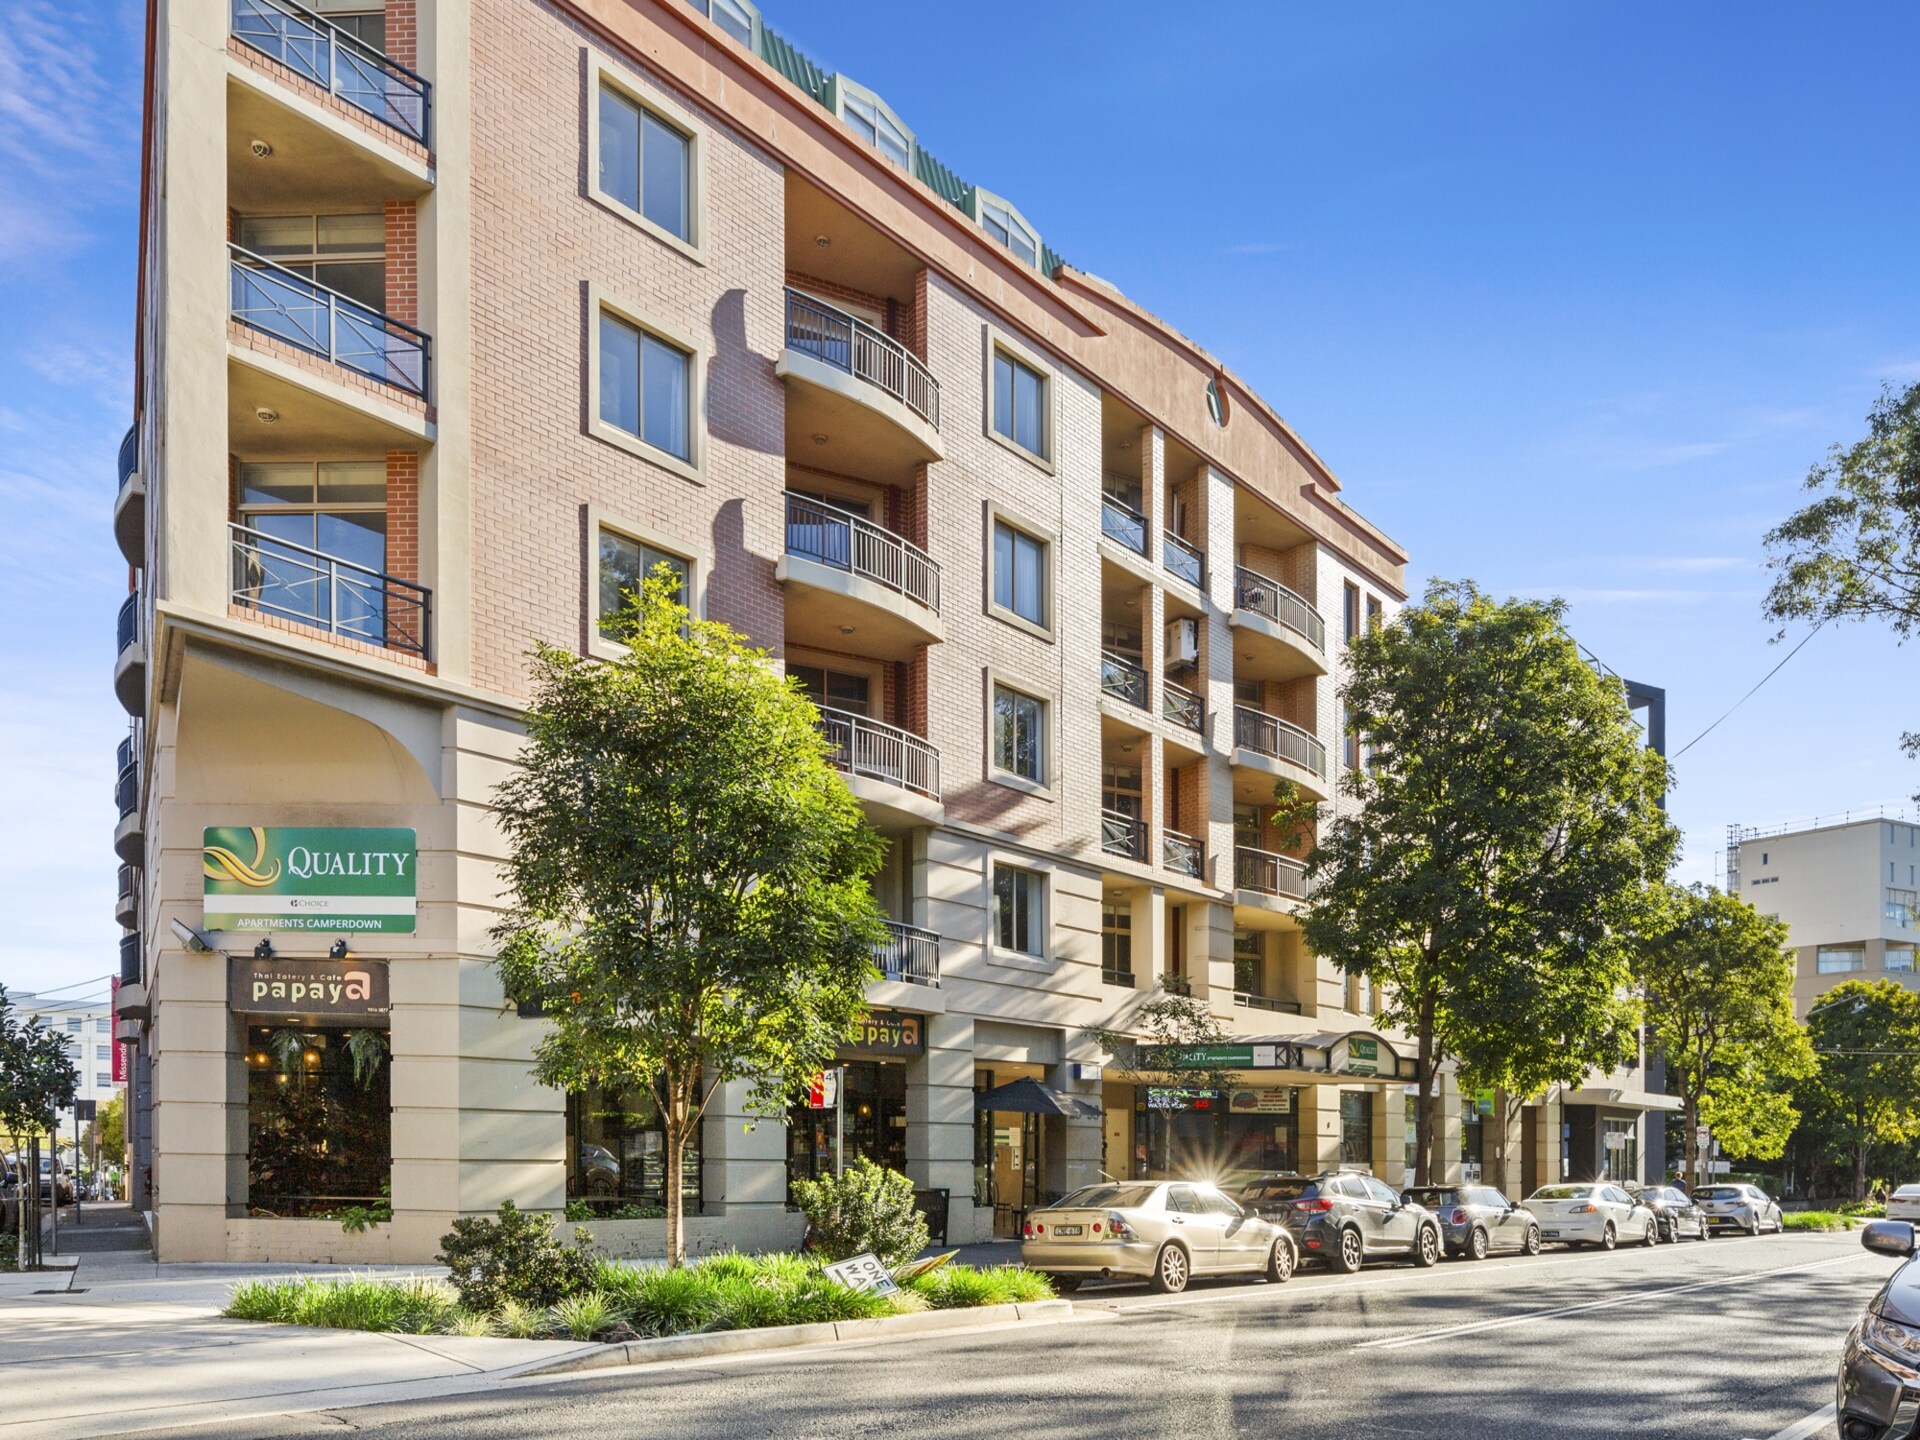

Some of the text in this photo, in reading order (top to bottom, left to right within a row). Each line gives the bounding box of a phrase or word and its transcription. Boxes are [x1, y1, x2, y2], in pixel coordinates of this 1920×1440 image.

[288, 846, 410, 879] QUALITY
[298, 900, 329, 908] CHOICE
[237, 918, 382, 929] APARTMENTS CAMPERDOWN
[252, 971, 371, 1005] papaya
[253, 972, 273, 980] Thai
[276, 973, 306, 982] Eatery
[319, 974, 342, 982] Cafe
[854, 1018, 919, 1049] apaya
[119, 1043, 128, 1080] Missende
[845, 1263, 867, 1286] WA
[862, 1261, 891, 1290] ONE
